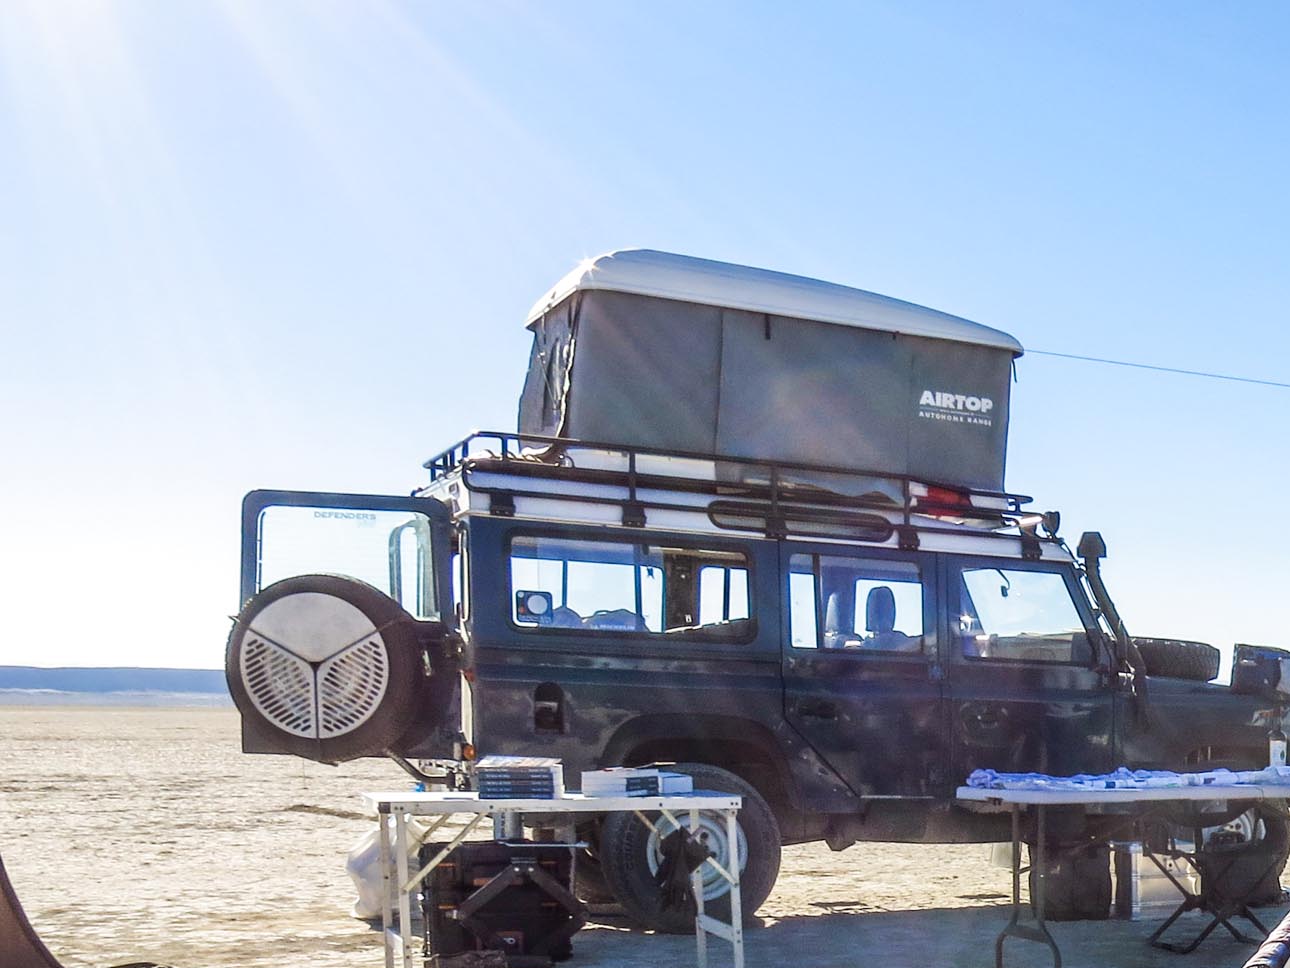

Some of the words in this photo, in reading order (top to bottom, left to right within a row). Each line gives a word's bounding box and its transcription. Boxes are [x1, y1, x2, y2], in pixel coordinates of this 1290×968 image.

[919, 390, 993, 413] AIRTOP
[919, 411, 964, 423] AUTOHOME
[967, 417, 992, 427] RANGE
[314, 511, 377, 520] DEFENDERS
